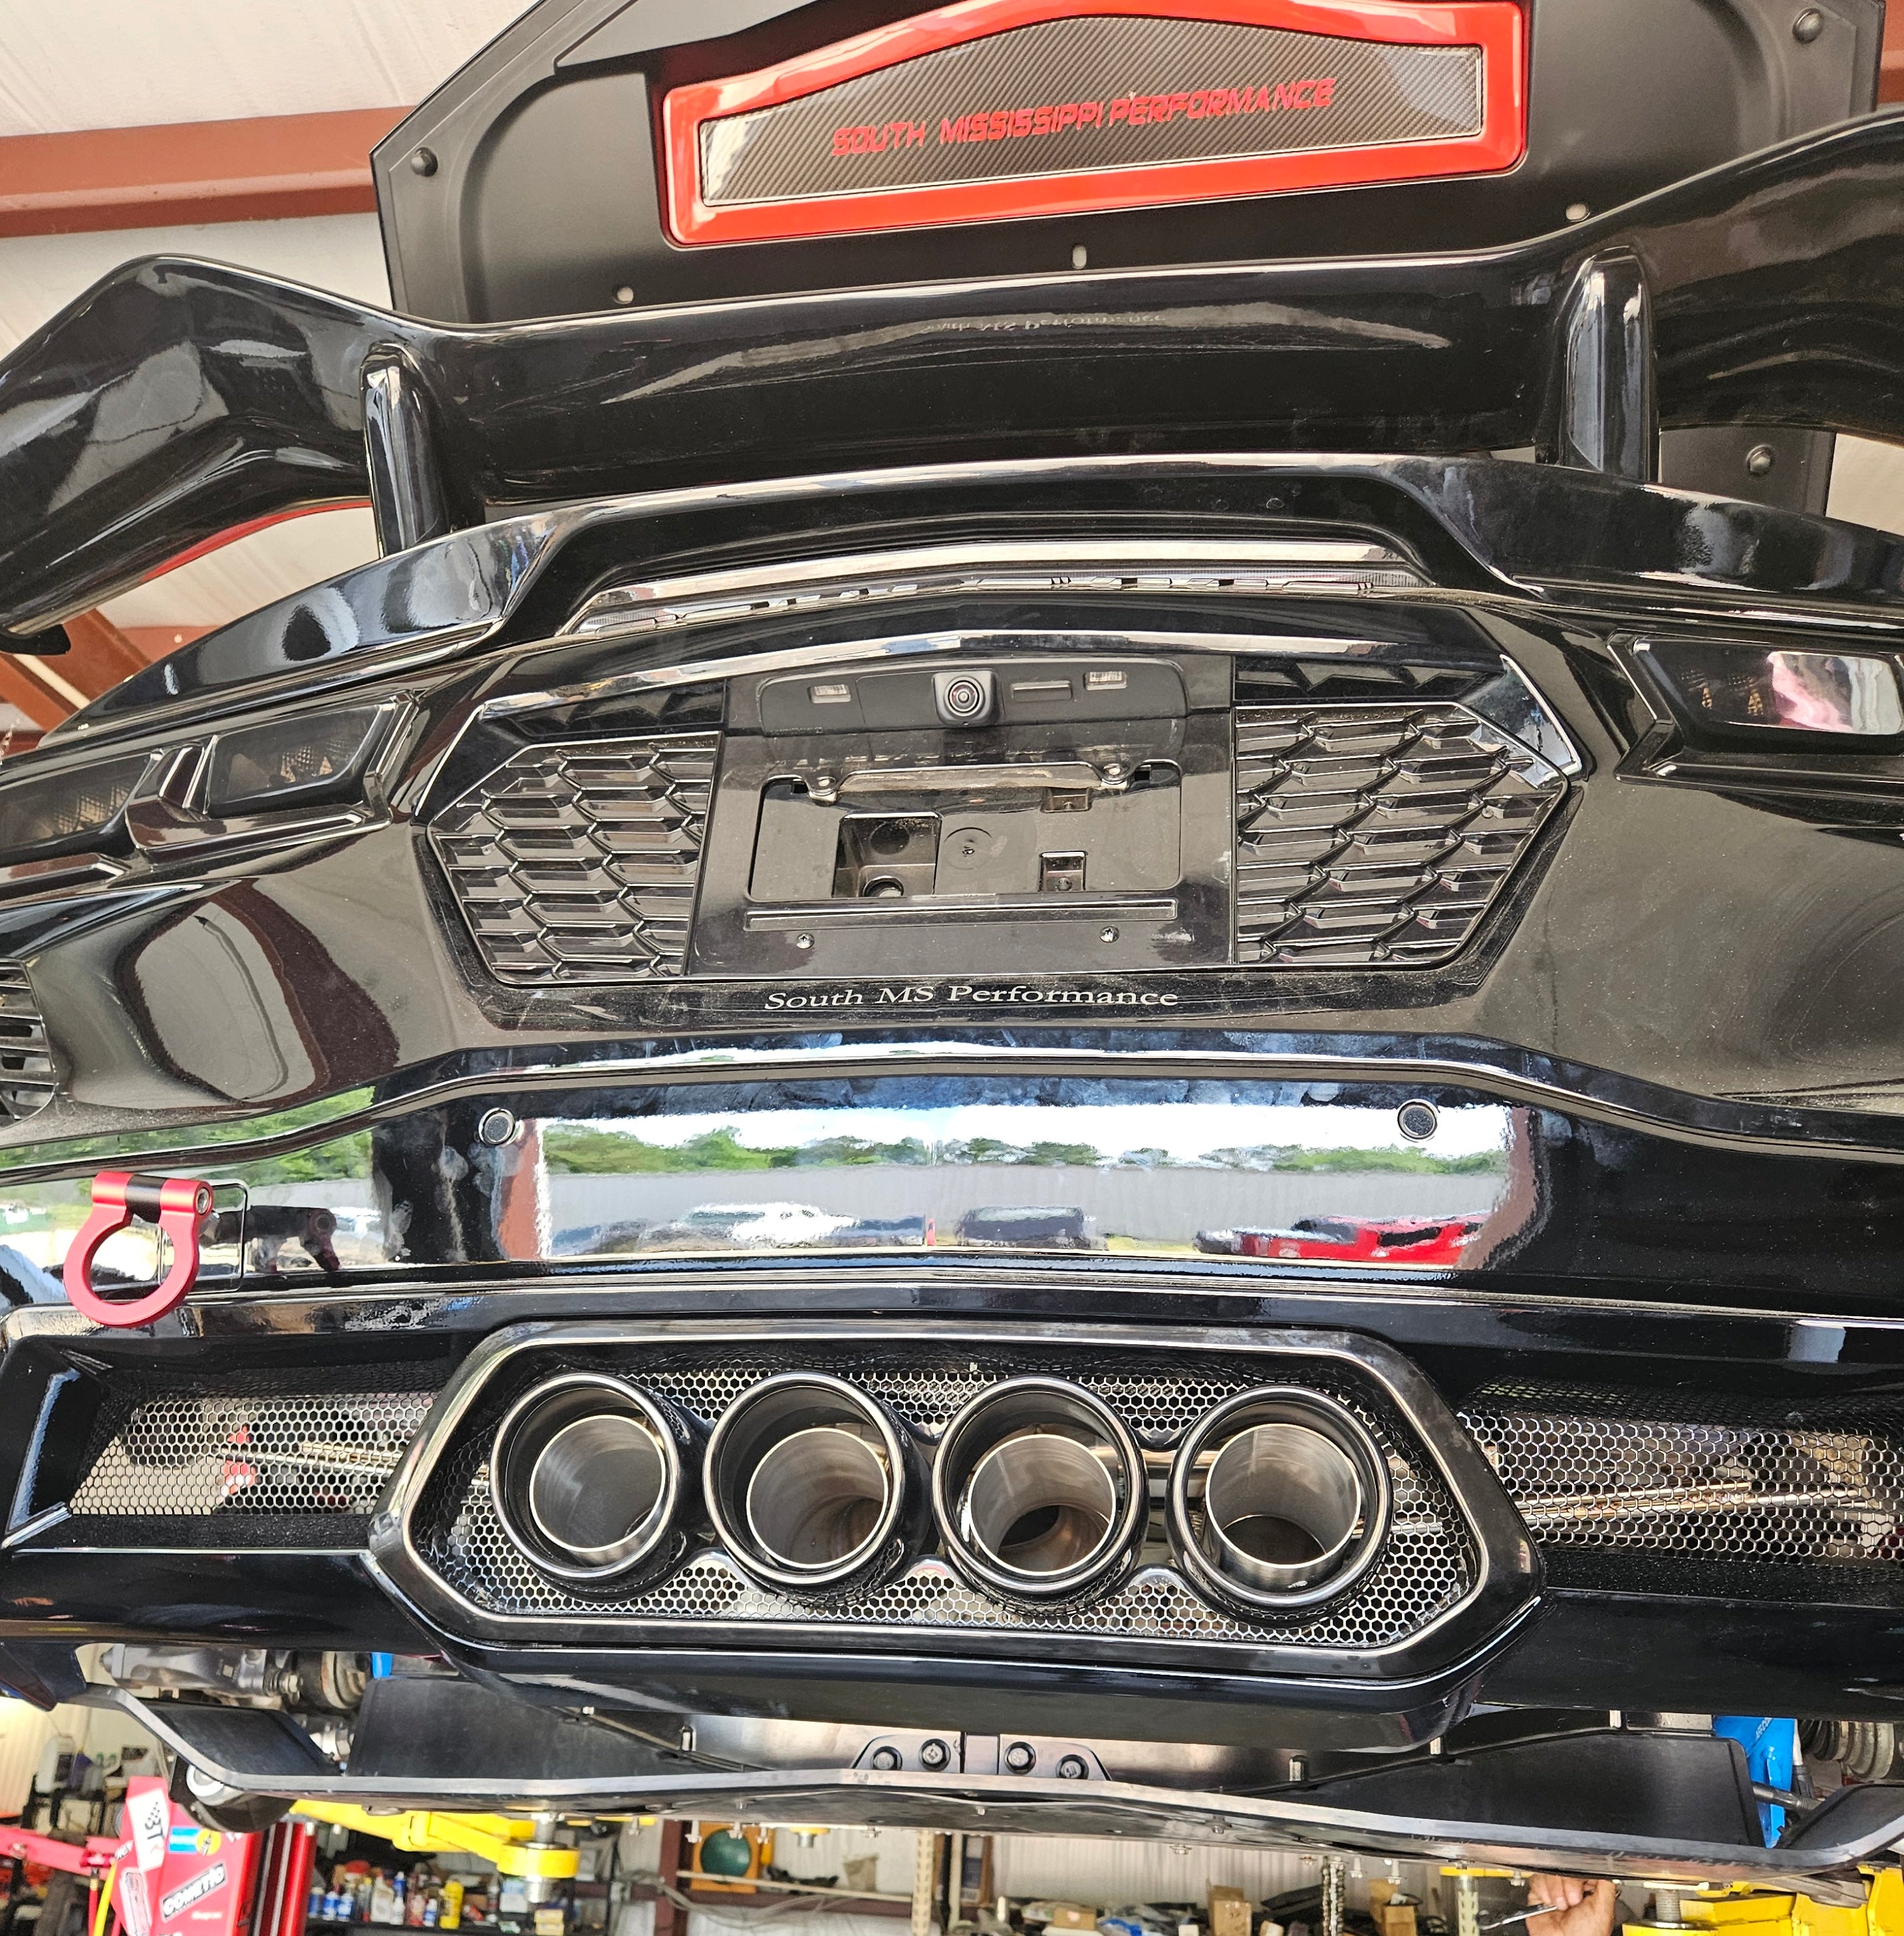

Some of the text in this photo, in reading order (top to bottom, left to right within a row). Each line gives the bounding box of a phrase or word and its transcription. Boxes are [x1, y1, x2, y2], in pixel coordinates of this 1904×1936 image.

[831, 78, 1337, 157] SOUTH MISSISSIPPI PERFORMANCE
[764, 985, 1180, 1010] South MS Performance
